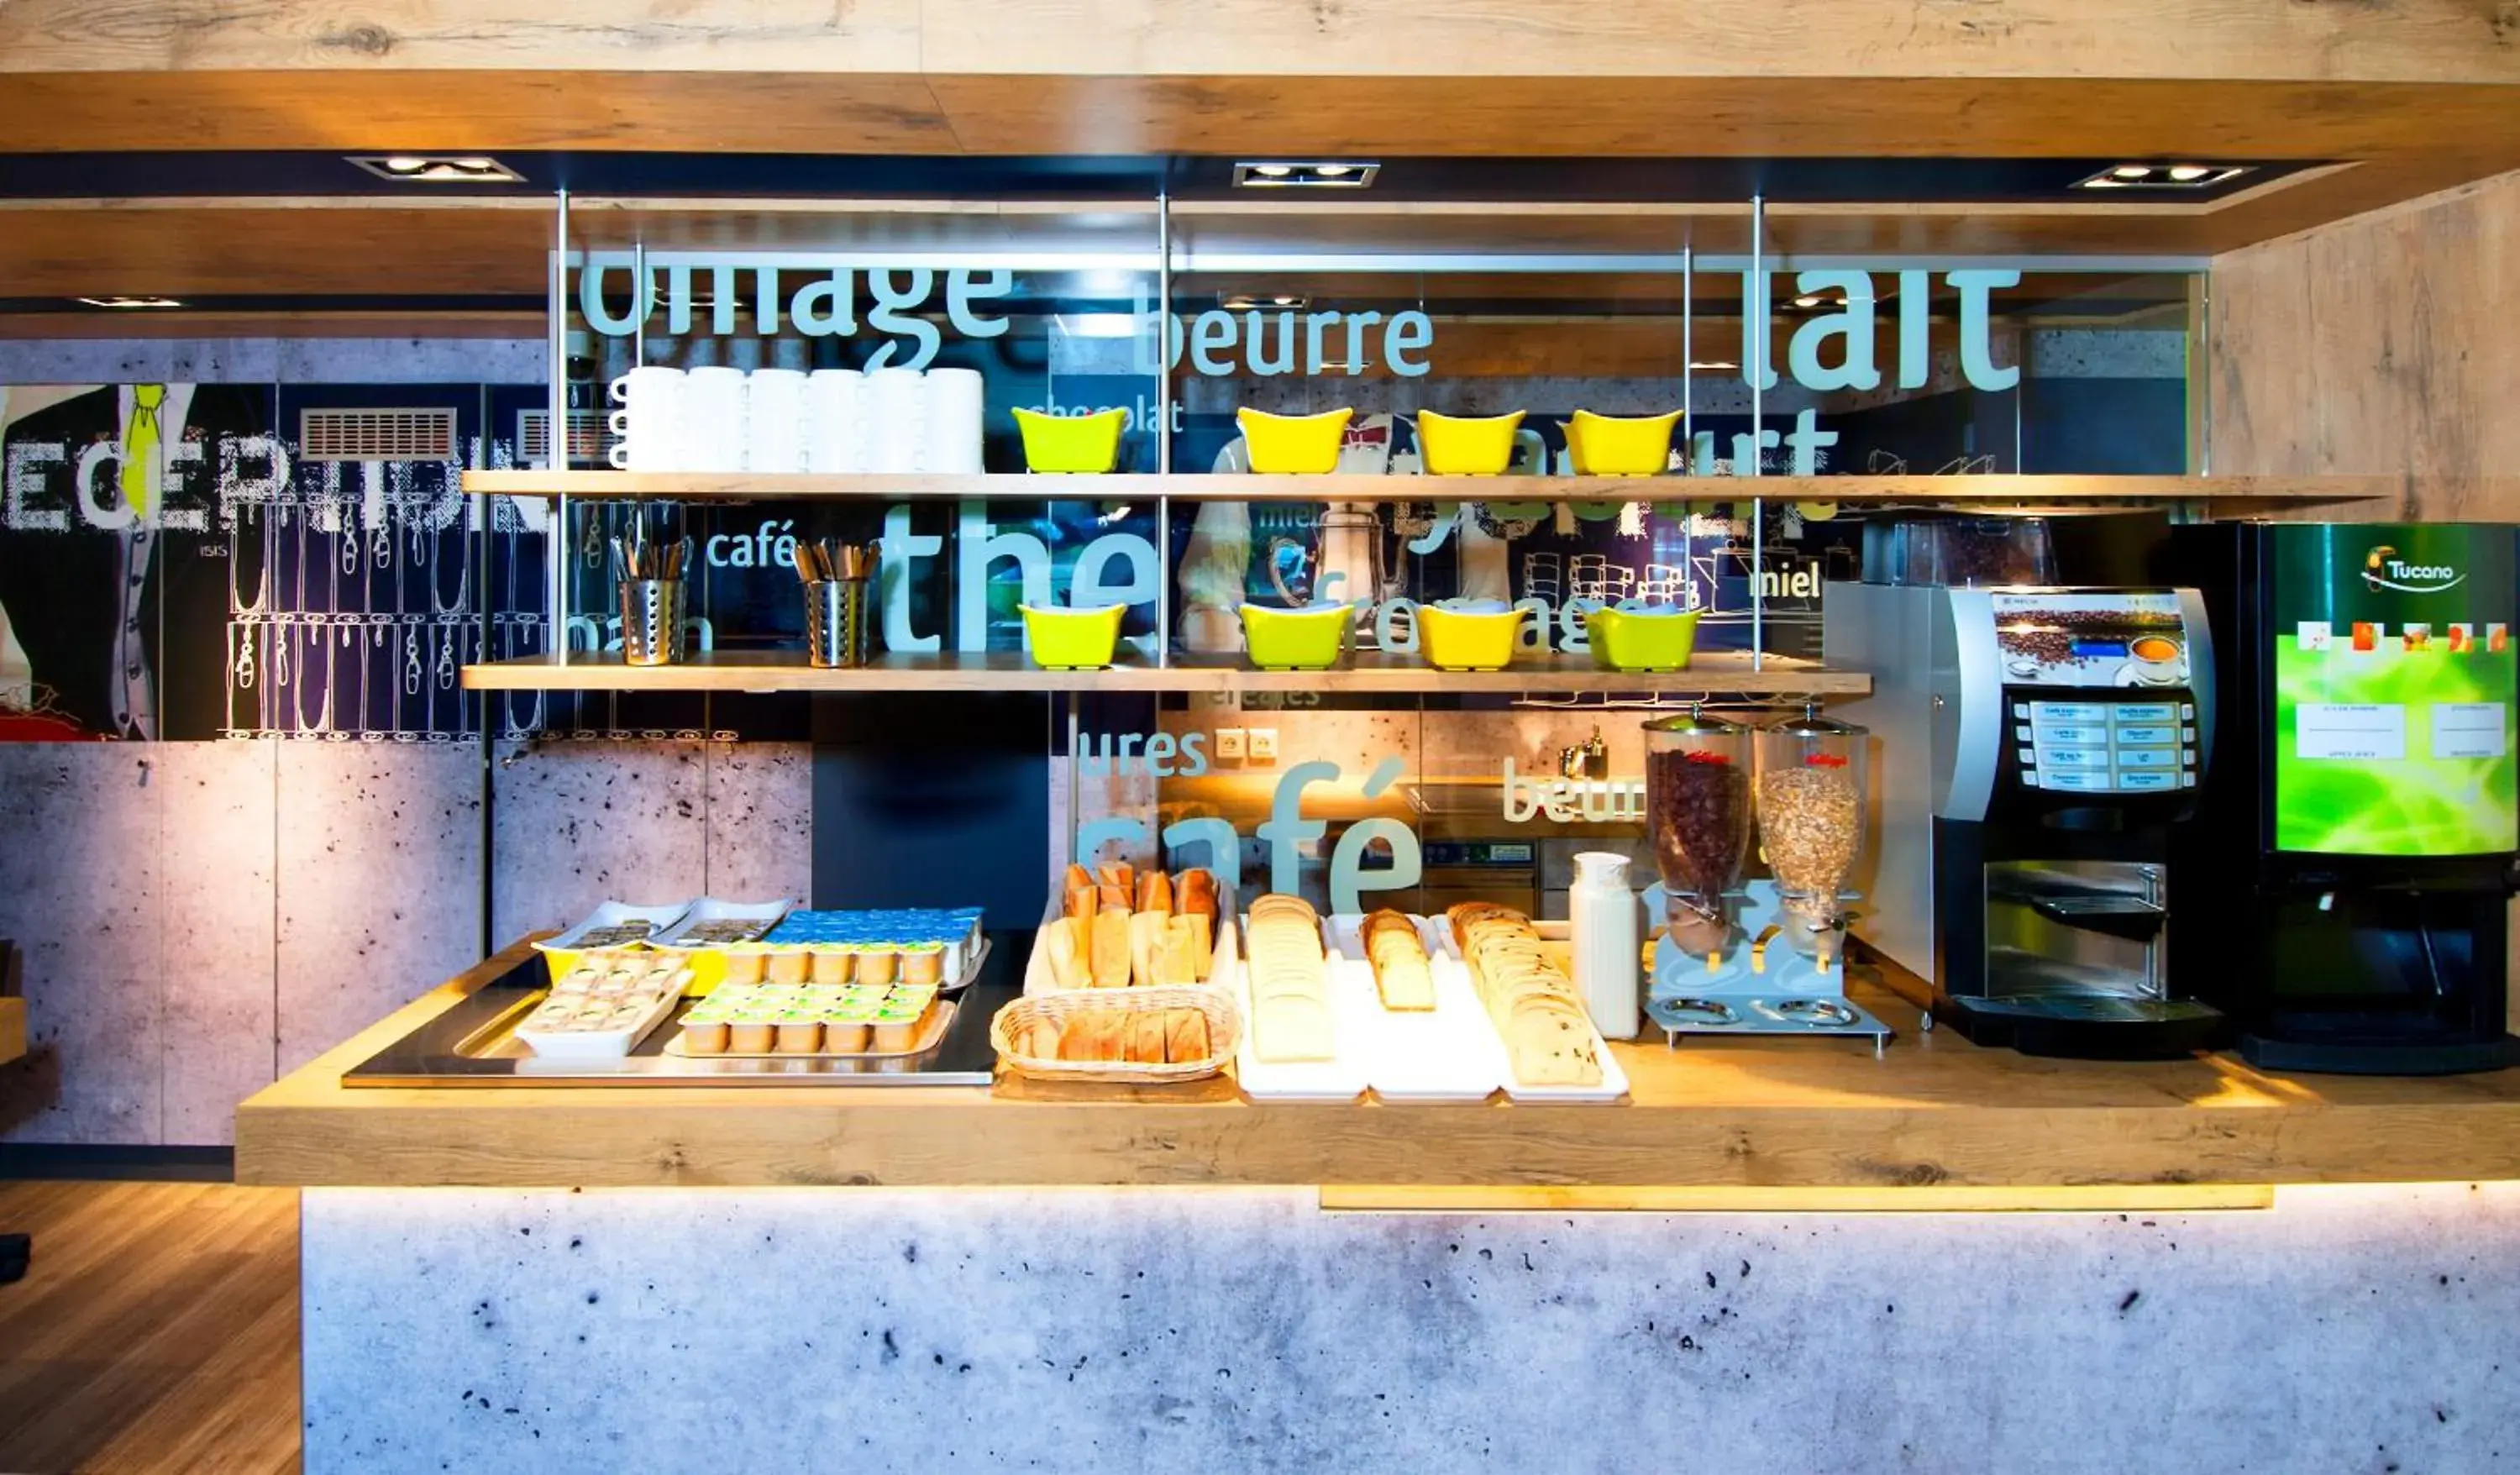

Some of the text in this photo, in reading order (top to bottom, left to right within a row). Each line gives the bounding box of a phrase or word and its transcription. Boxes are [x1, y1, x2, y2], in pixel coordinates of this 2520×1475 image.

[1134, 282, 1434, 376] beurre
[1741, 270, 2021, 391] lait
[707, 520, 797, 567] café
[1750, 561, 1820, 597] miel
[2386, 560, 2454, 579] Tucano
[1078, 732, 1208, 777] ures
